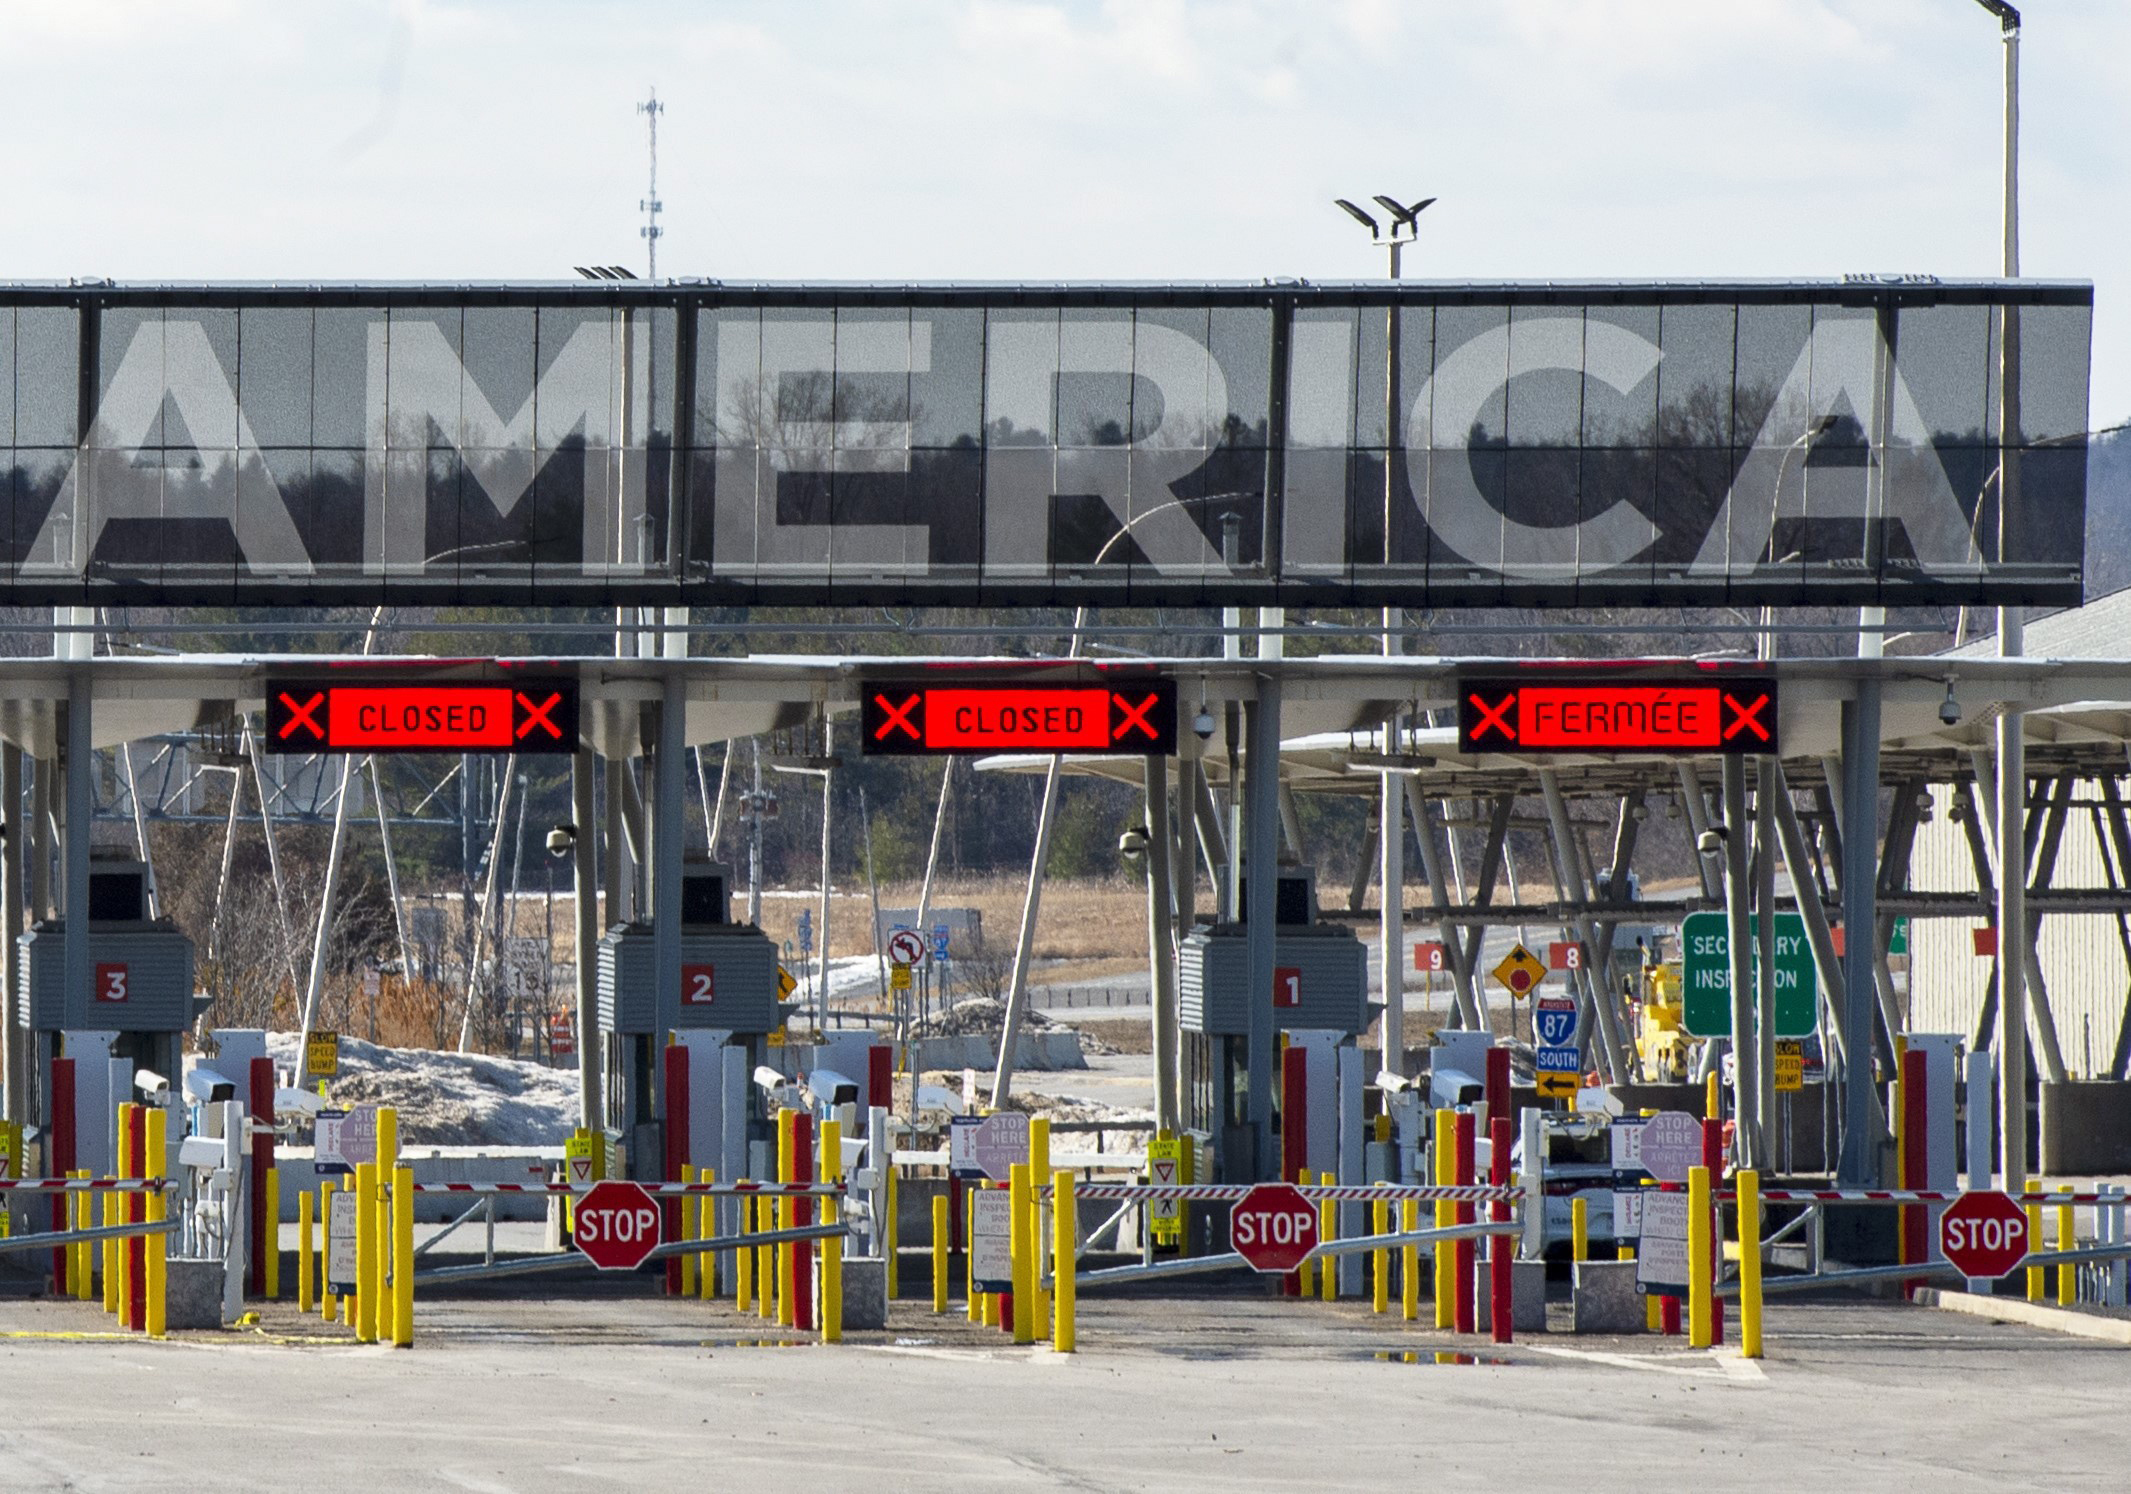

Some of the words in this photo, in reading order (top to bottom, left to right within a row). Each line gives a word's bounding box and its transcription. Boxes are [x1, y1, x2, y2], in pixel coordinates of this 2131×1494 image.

[19, 318, 1988, 578] AMERICA
[358, 704, 488, 733] CLOSED
[954, 706, 1084, 733] CLOSED
[1535, 692, 1699, 734] FERMÉE
[1430, 949, 1443, 970] 9
[1566, 947, 1580, 969] 8
[106, 972, 126, 1000] 3
[691, 974, 713, 1003] 2
[1286, 976, 1299, 1005] 1
[1544, 1014, 1569, 1038] 87
[1540, 1051, 1578, 1068] SOUTH
[355, 1109, 377, 1122] STO
[991, 1117, 1026, 1130] STOP
[1656, 1116, 1692, 1130] STOP
[991, 1131, 1026, 1144] HERE
[1655, 1131, 1692, 1145] HERE
[1648, 1194, 1687, 1205] ADVANC
[580, 1209, 655, 1242] STOP
[1237, 1211, 1312, 1244] STOP
[1947, 1217, 2024, 1251] STOP
